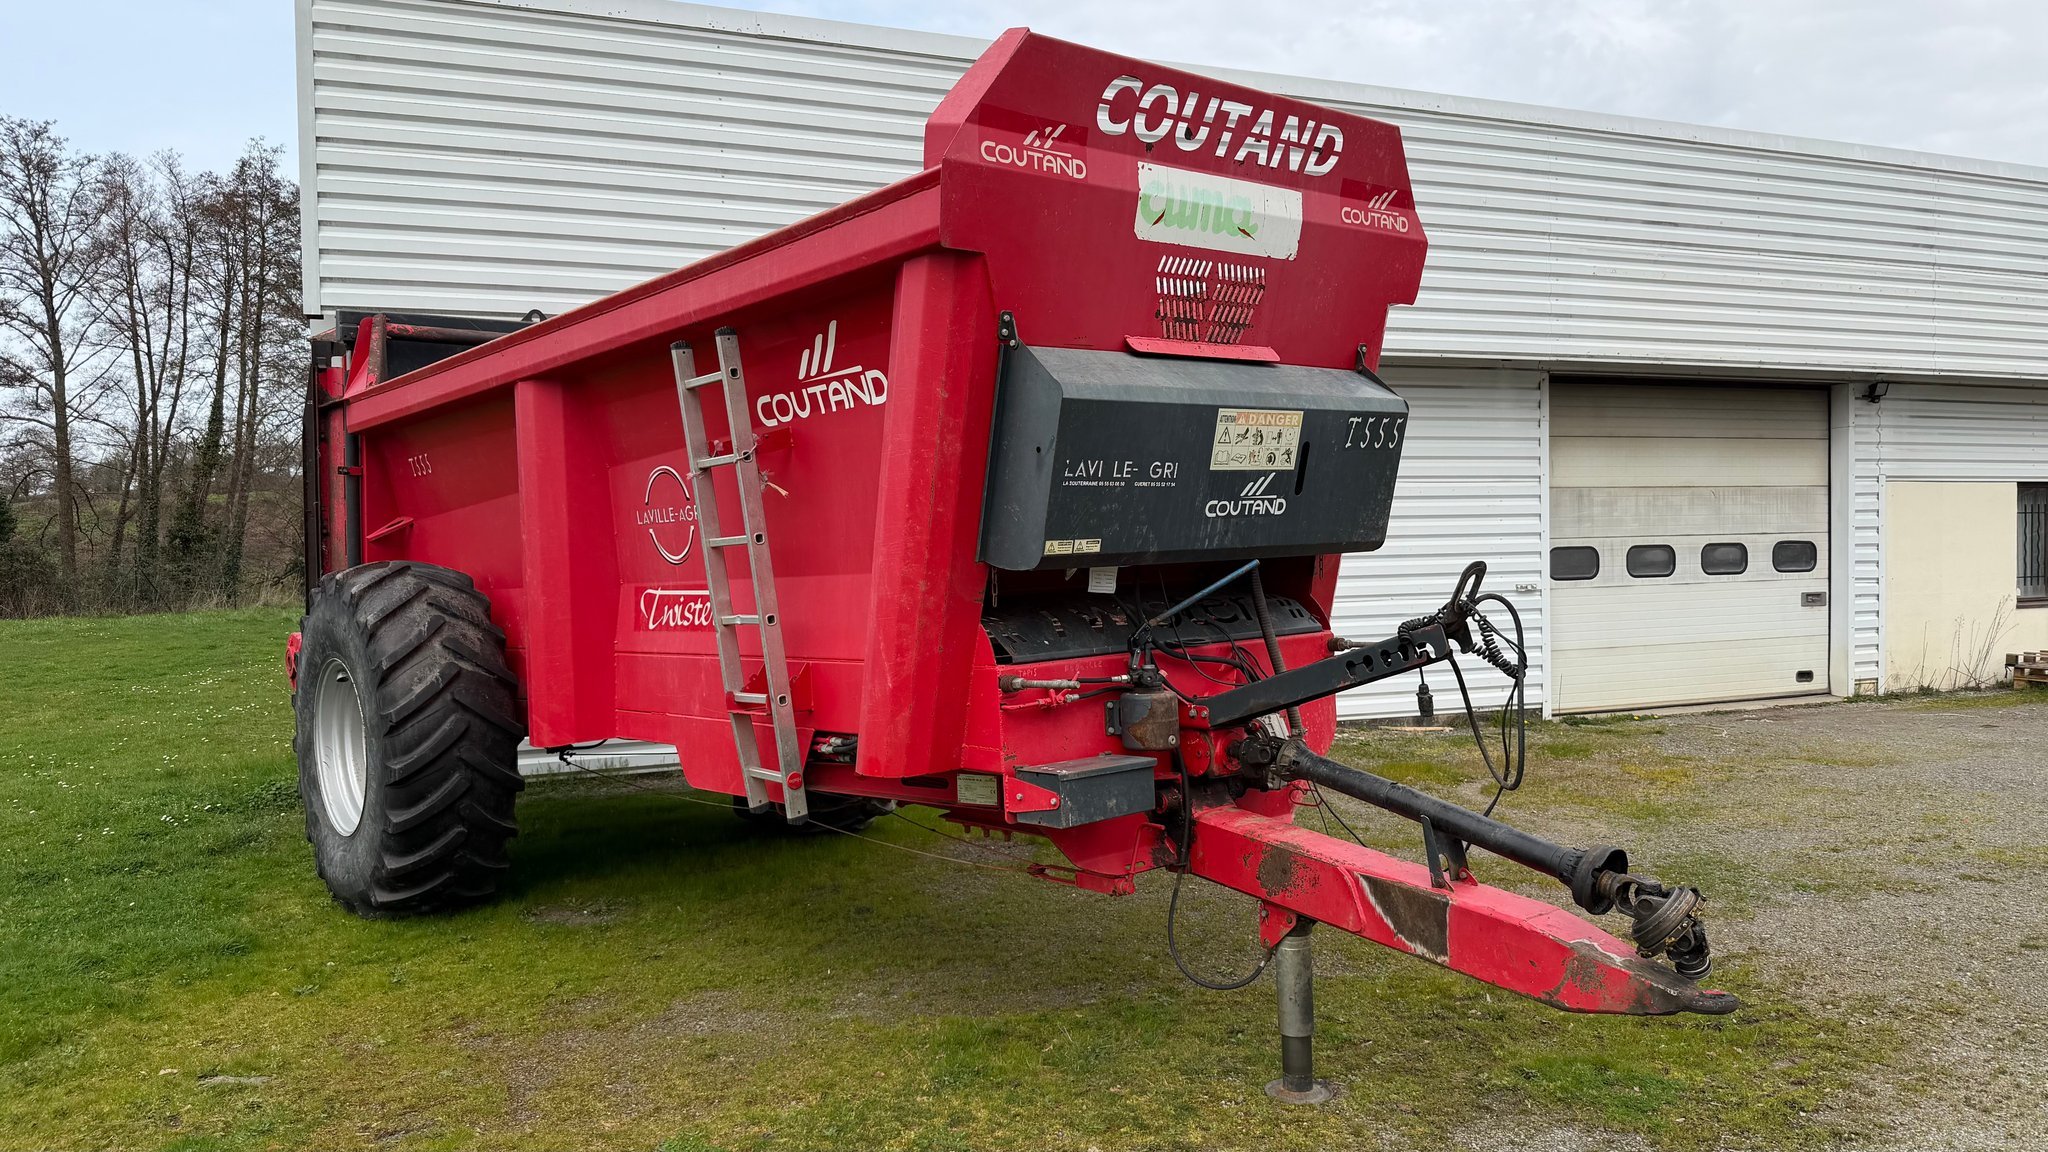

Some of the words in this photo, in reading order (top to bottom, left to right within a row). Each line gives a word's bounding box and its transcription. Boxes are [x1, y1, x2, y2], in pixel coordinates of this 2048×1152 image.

[1096, 74, 1344, 177] COUTAND
[980, 140, 1087, 179] COUTAND
[1341, 206, 1409, 233] COUTAND
[756, 369, 889, 427] COUTAND
[1248, 413, 1299, 426] DANGER
[1345, 416, 1405, 449] T555
[636, 505, 699, 525] LAVILLE-AGR
[1205, 498, 1287, 518] COUTAND
[640, 586, 716, 630] Twiste
